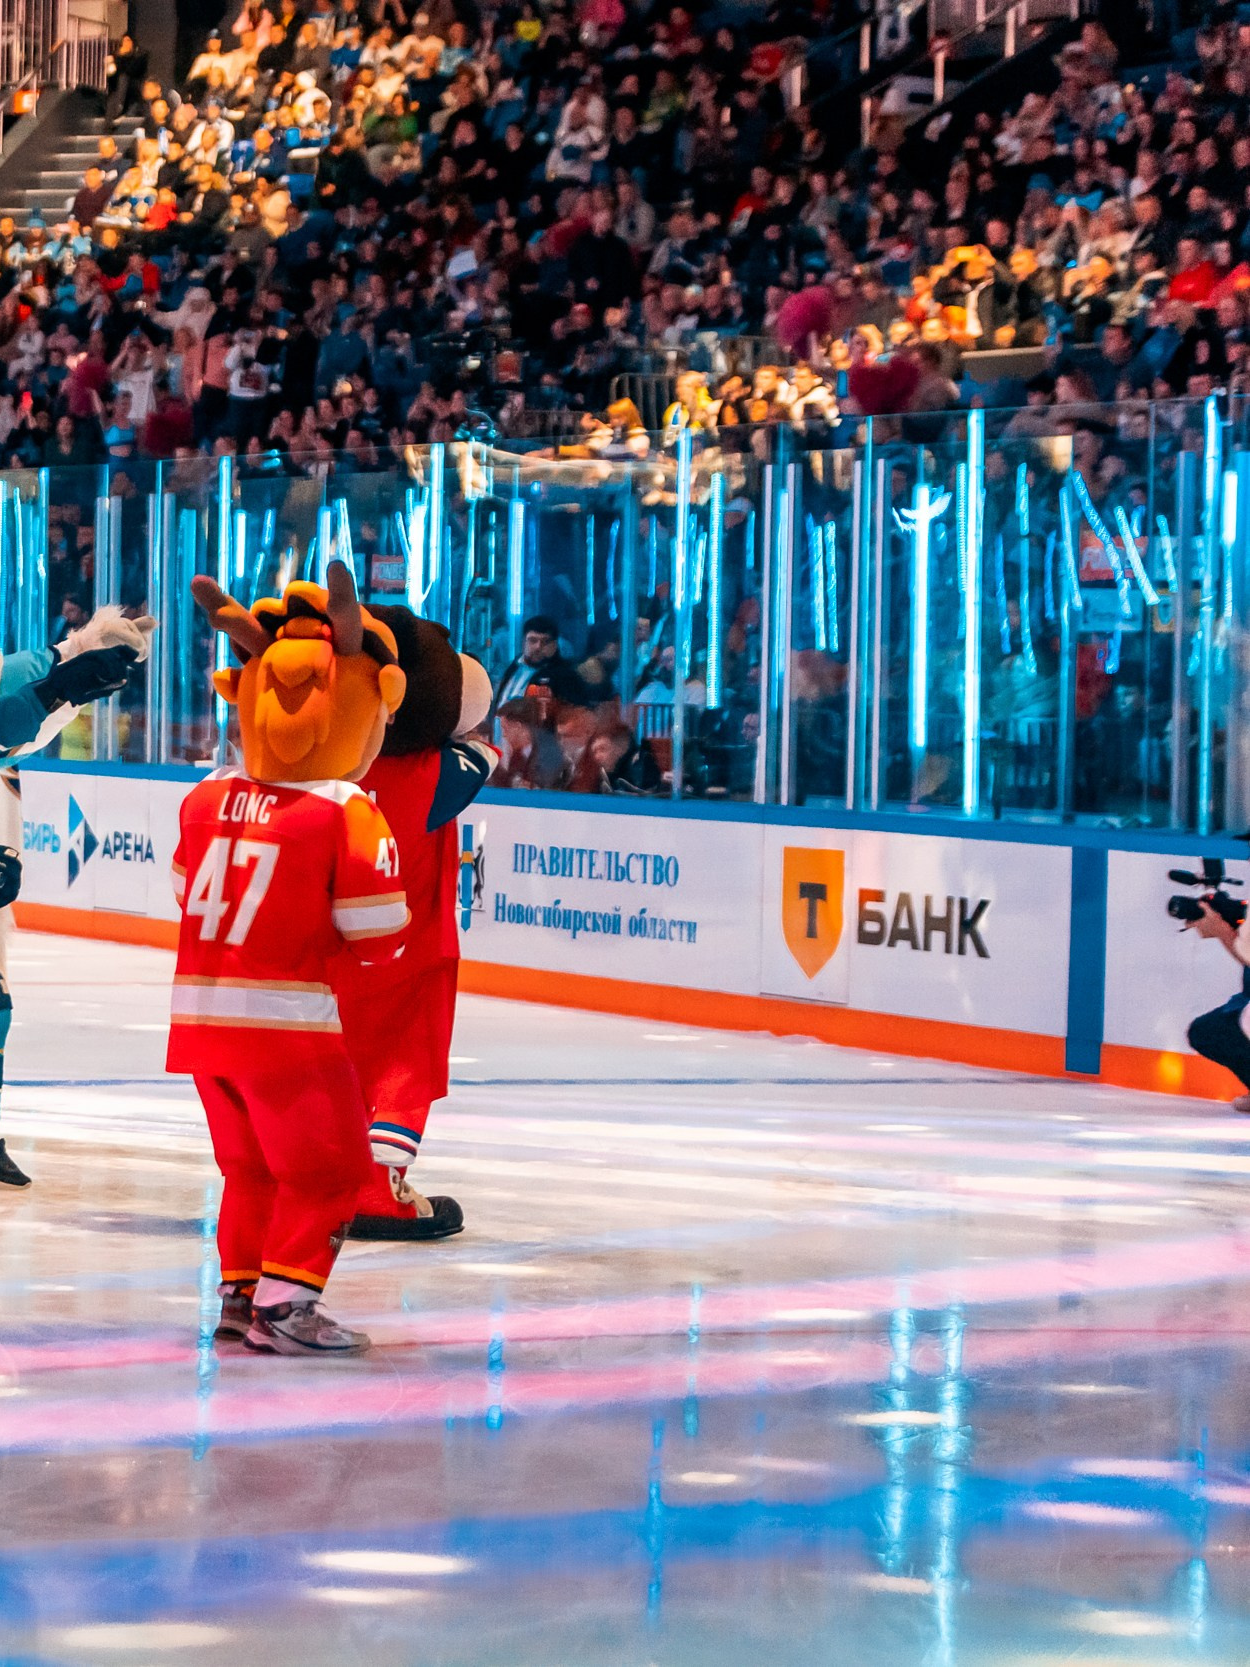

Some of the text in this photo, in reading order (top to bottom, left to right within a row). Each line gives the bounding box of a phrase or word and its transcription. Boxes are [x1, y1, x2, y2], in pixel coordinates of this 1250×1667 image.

[217, 790, 279, 825] LONG
[101, 830, 156, 865] АРЕНА
[374, 836, 400, 879] 47
[512, 842, 680, 888] ПРАВИТЕЛЬСТВО
[185, 836, 282, 947] 47
[493, 892, 698, 945] Новосибирской области
[856, 887, 992, 960] БАНК
